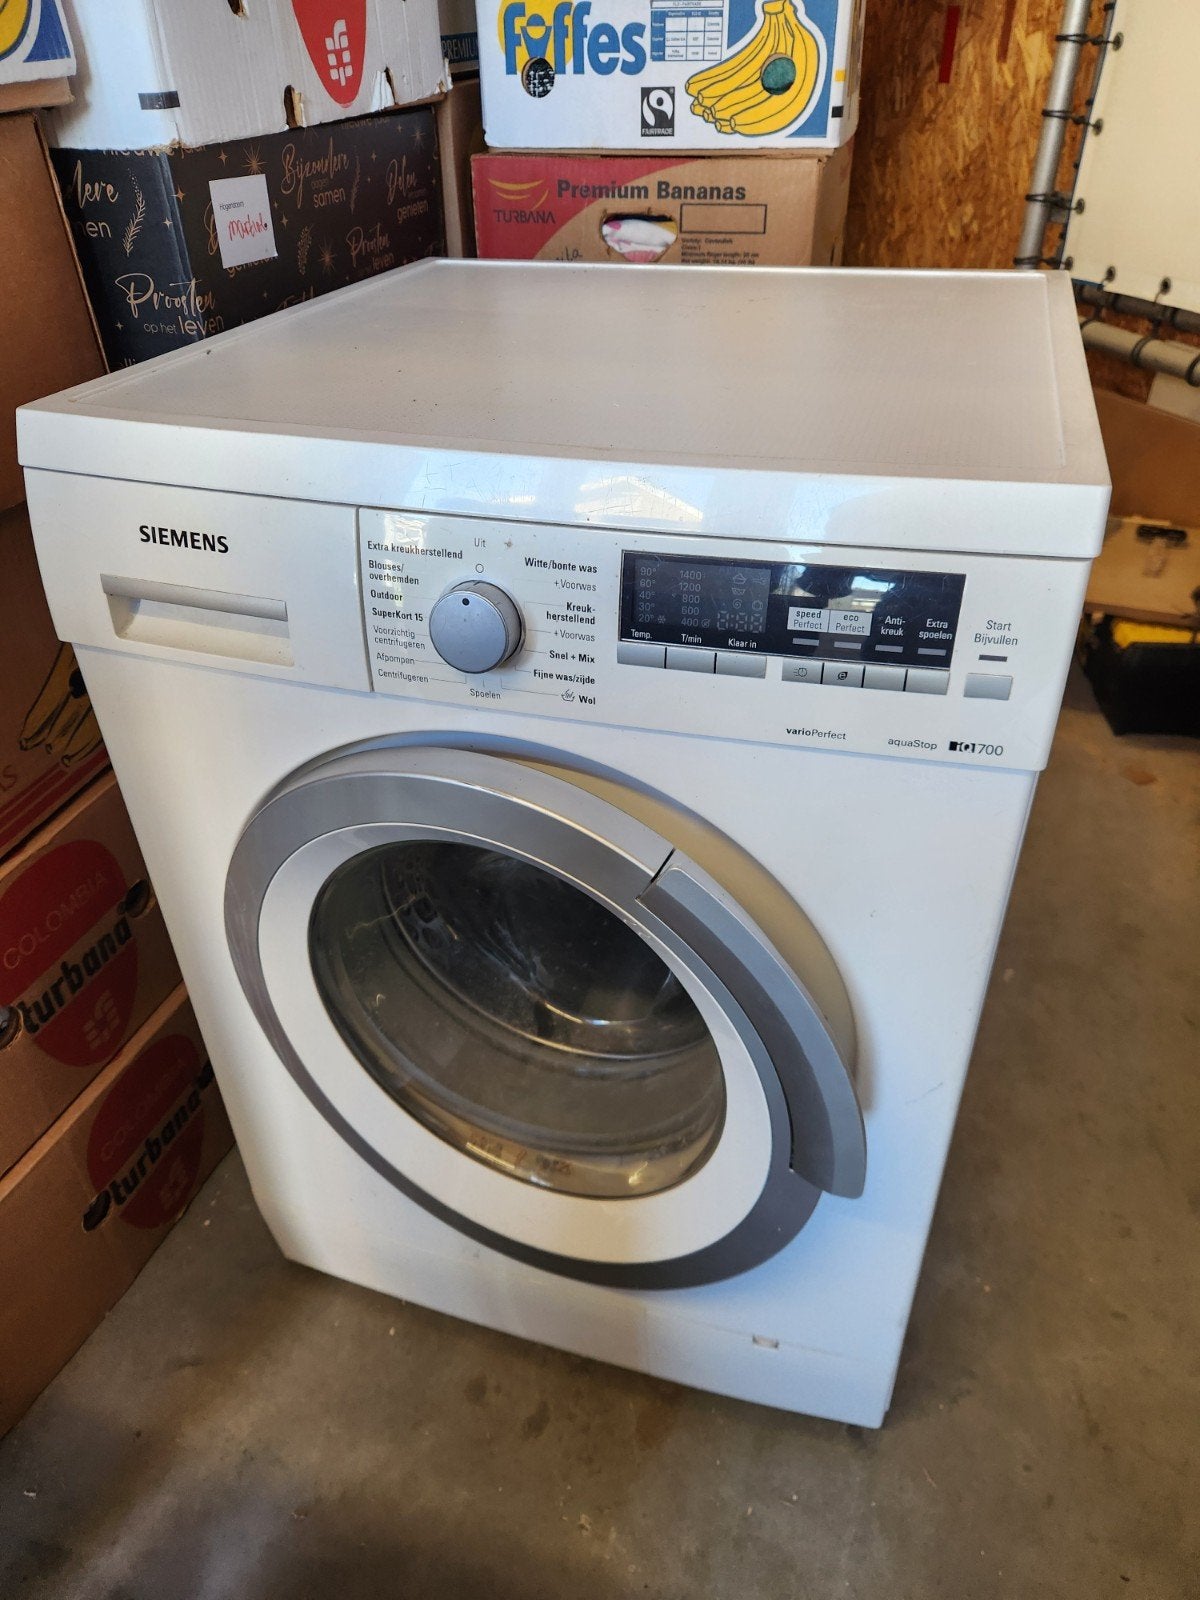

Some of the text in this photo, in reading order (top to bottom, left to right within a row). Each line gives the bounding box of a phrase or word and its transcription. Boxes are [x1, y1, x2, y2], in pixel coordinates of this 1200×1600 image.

[280, 136, 350, 209] Bijzondere
[557, 179, 746, 200] Premium Bananas
[313, 186, 346, 209] samen
[493, 209, 555, 224] TURBANA
[115, 273, 216, 319] Proosten
[143, 314, 225, 336] op het leven
[139, 525, 229, 553] SIEMENS
[474, 538, 486, 548] Uit
[367, 541, 463, 559] Extra kreukherstellend
[368, 560, 404, 573] Blouses/
[524, 557, 598, 574] Witte/bonte was
[369, 573, 419, 585] overhemden
[678, 582, 701, 592] 1200
[370, 589, 403, 601] Outdoor
[566, 602, 596, 613] Kreuk-
[372, 608, 424, 622] SuperKort 15
[546, 611, 596, 625] herstellend
[795, 610, 822, 620] speed
[843, 614, 859, 623] eco
[884, 615, 906, 625] Anti-
[681, 618, 699, 628] 400
[793, 619, 822, 631] Perfect
[835, 623, 865, 634] Perfect
[926, 619, 948, 629] Extra
[986, 620, 1012, 632] Start
[373, 625, 415, 639] Voorzichtig
[630, 628, 653, 639] Temp.
[880, 626, 904, 636] kreuk
[918, 630, 952, 641] spoelen
[374, 637, 425, 650] centrifugeren
[681, 633, 702, 644] T/min
[728, 638, 757, 649] Klaar in
[974, 633, 1018, 647] Bijvullen
[376, 652, 415, 665] Afpompen
[549, 650, 568, 660] Snel
[578, 653, 595, 664] Mix
[378, 669, 429, 683] Centrifugeren
[533, 669, 596, 685] Fijne was/zijde
[470, 688, 500, 699] Spoelen
[579, 695, 596, 705] Wol
[786, 726, 846, 740] varioPerfect
[887, 737, 937, 750] aquaStop
[3, 871, 108, 970] COLOMBIA
[18, 917, 133, 1036] turbana
[108, 1088, 201, 1206] turbana
